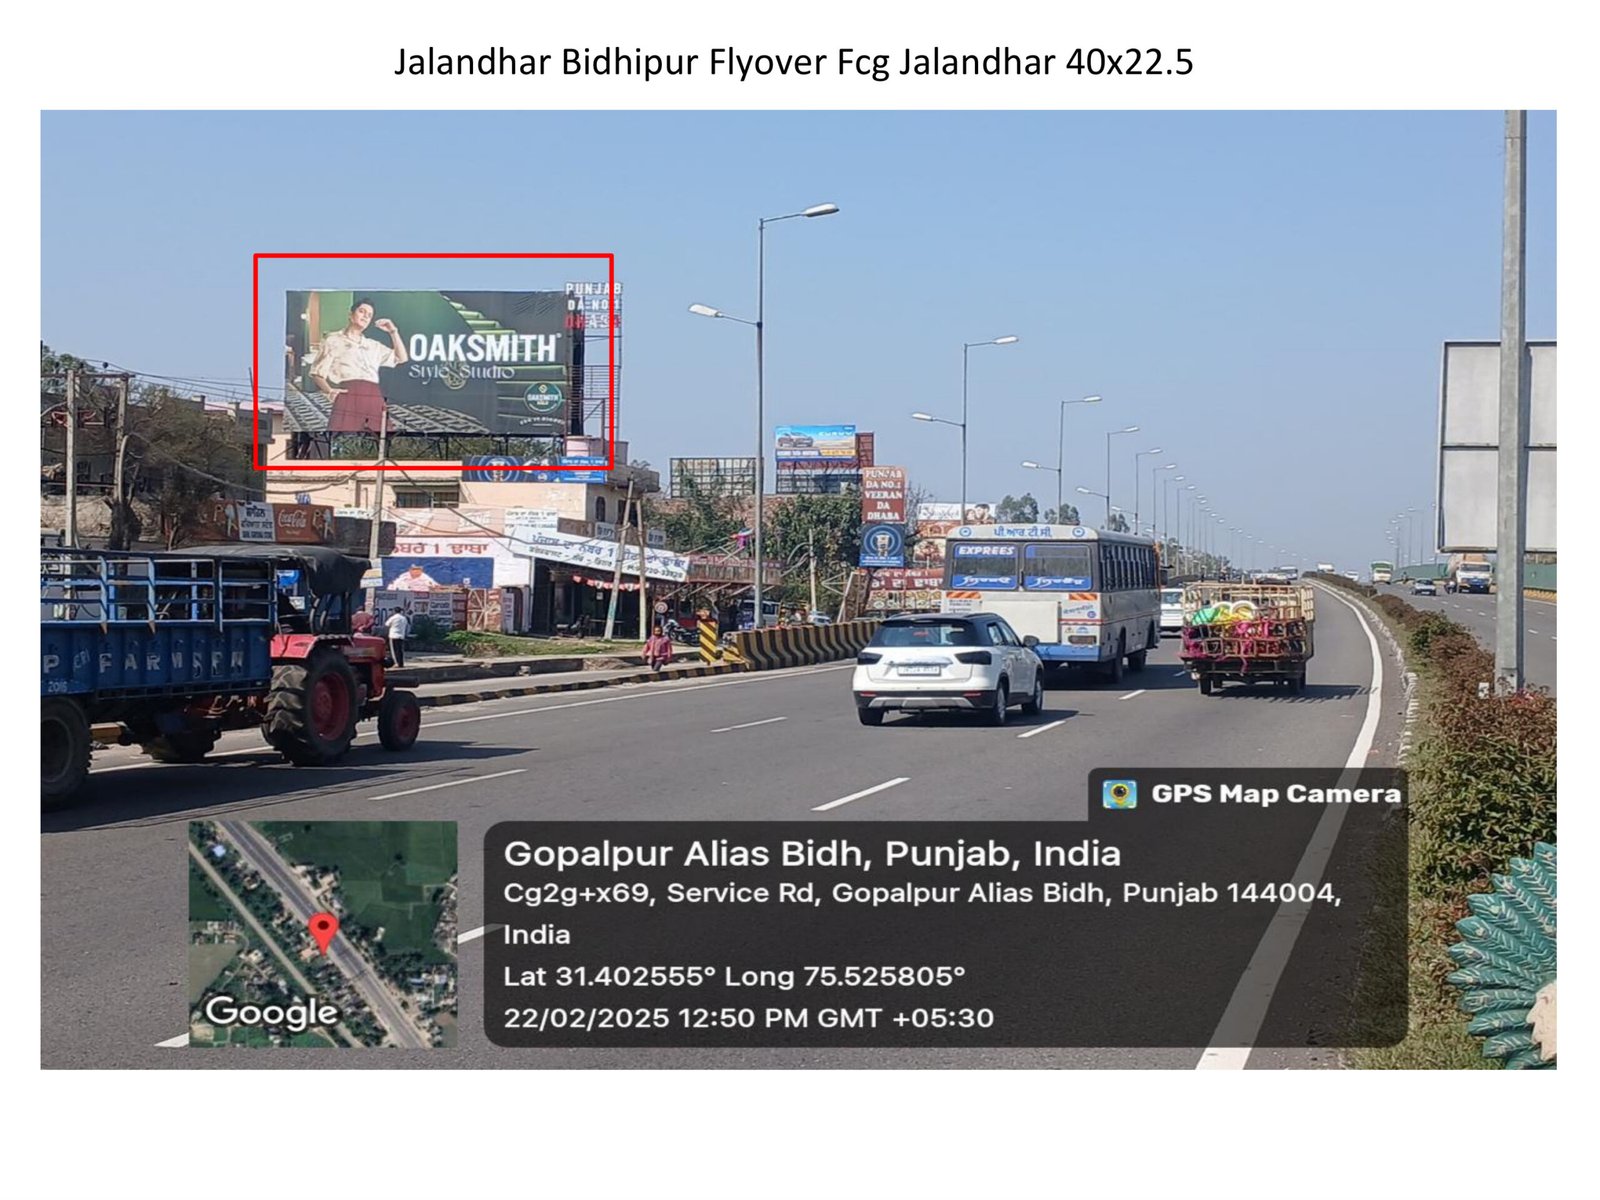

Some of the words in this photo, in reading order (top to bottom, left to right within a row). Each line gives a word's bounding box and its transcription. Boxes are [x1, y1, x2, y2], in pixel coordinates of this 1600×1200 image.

[565, 282, 621, 295] PUNJAB
[409, 333, 557, 362] OAKSMITH
[865, 470, 902, 478] PUNJAB
[866, 480, 879, 489] DA
[864, 490, 903, 499] VEERAN
[876, 501, 890, 510] DA
[867, 512, 900, 520] DHABA
[958, 545, 1015, 556] EXPREES
